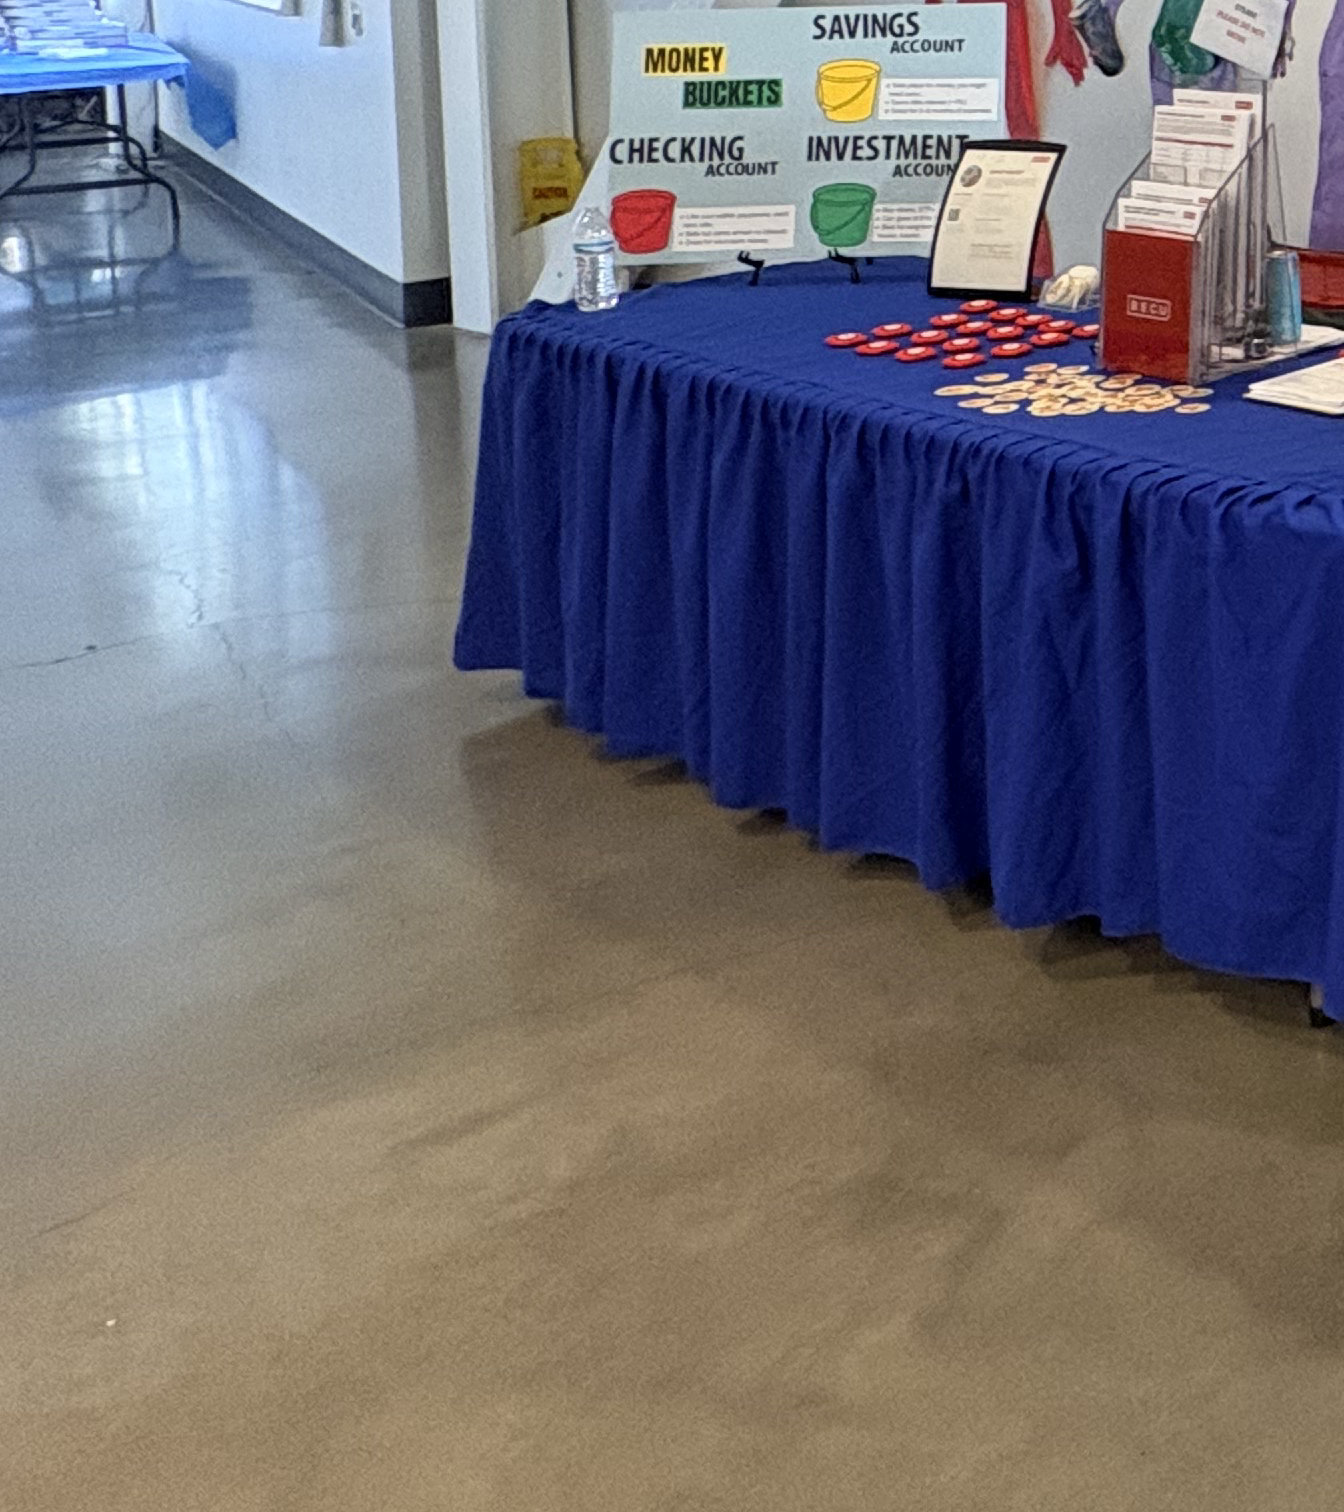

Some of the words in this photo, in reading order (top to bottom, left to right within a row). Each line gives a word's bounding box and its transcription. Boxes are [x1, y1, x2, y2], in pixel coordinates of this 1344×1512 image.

[813, 12, 919, 40] SAVINGS
[890, 38, 965, 54] ACCOUNT
[644, 47, 724, 74] MONEY
[683, 79, 783, 108] BUCKETS
[610, 136, 744, 164] CHECKING
[704, 161, 778, 178] ACCOUNT
[893, 162, 957, 178] ACCOUN
